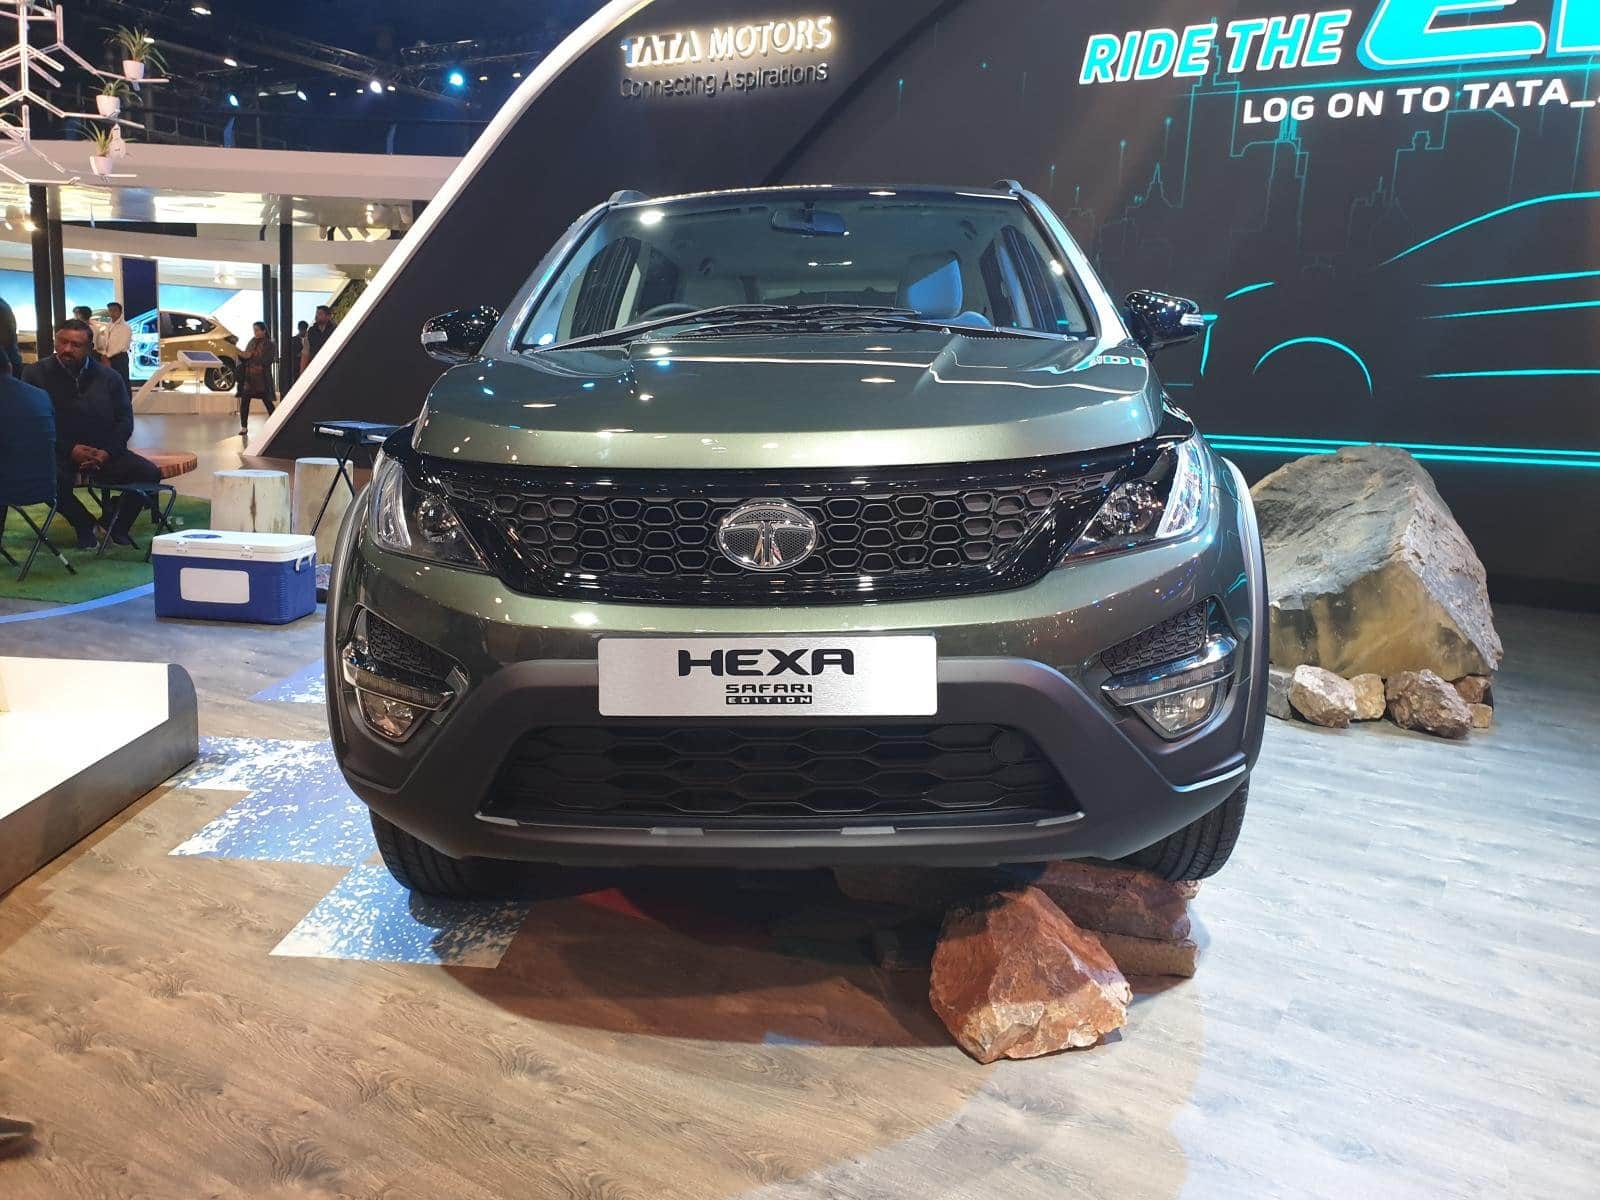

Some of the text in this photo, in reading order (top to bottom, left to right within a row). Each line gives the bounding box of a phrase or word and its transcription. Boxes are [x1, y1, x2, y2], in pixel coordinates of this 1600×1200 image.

[620, 15, 833, 68] TATA MOTORS
[1078, 23, 1219, 85] RIDE
[1226, 9, 1353, 74] THE
[620, 62, 829, 98] Connecting Aspirations
[1242, 95, 1315, 124] LOG
[1327, 90, 1384, 119] ON
[1396, 86, 1450, 114] TO
[678, 648, 855, 677] HEXA
[725, 683, 813, 694] SAFARI
[726, 696, 812, 704] EDITION
